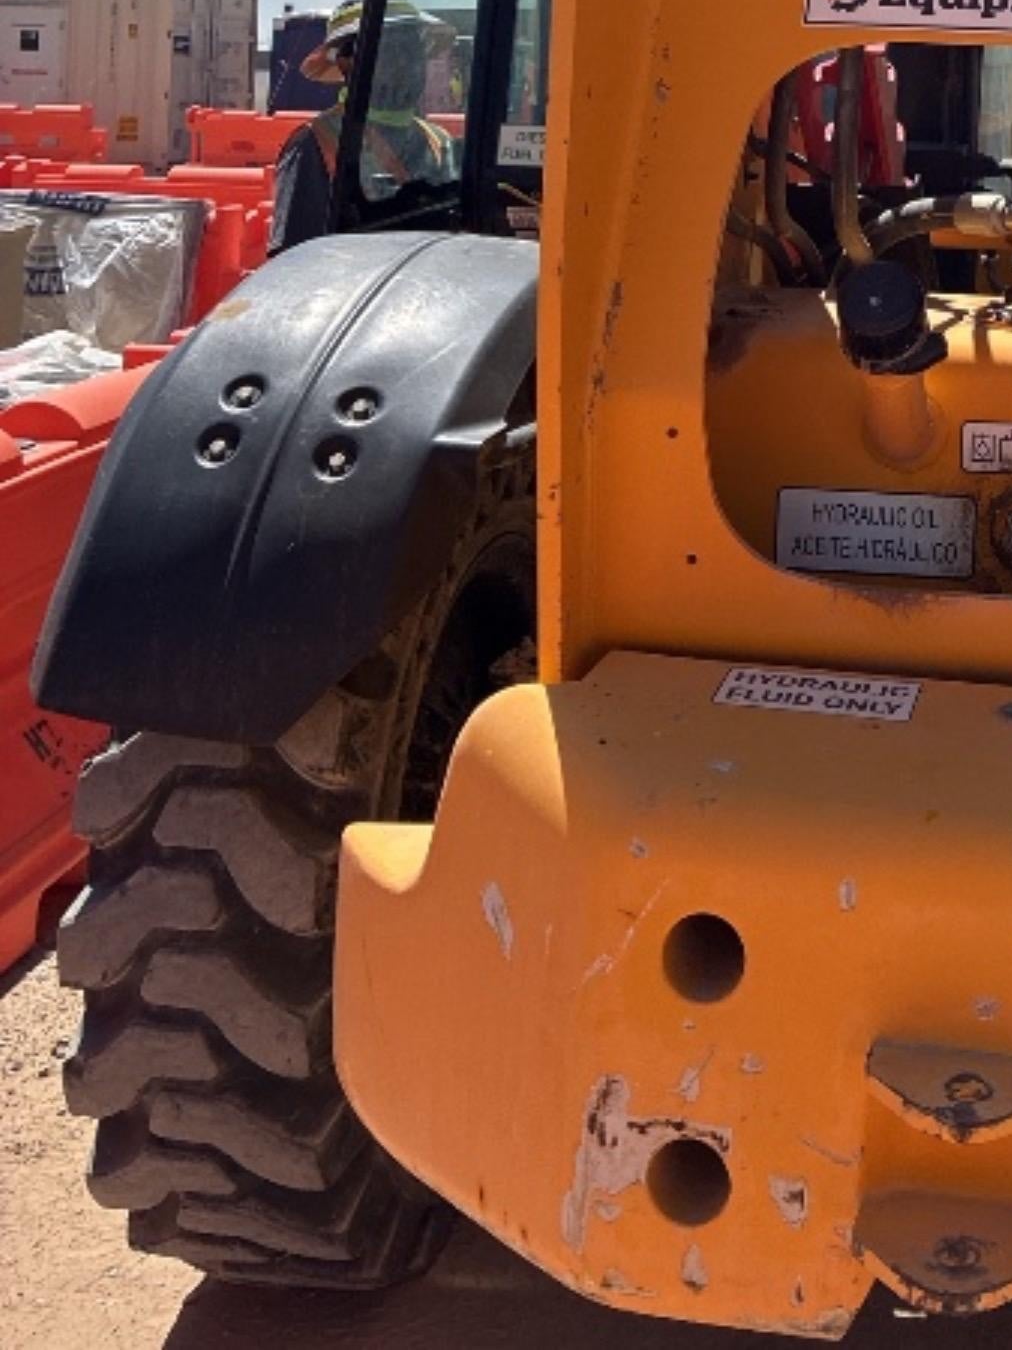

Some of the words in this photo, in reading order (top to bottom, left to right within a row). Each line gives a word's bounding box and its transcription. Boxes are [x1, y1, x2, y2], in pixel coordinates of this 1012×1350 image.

[912, 506, 940, 529] OL
[791, 536, 851, 559] ACETE
[725, 687, 814, 706] FLUID
[823, 697, 902, 715] ONLY
